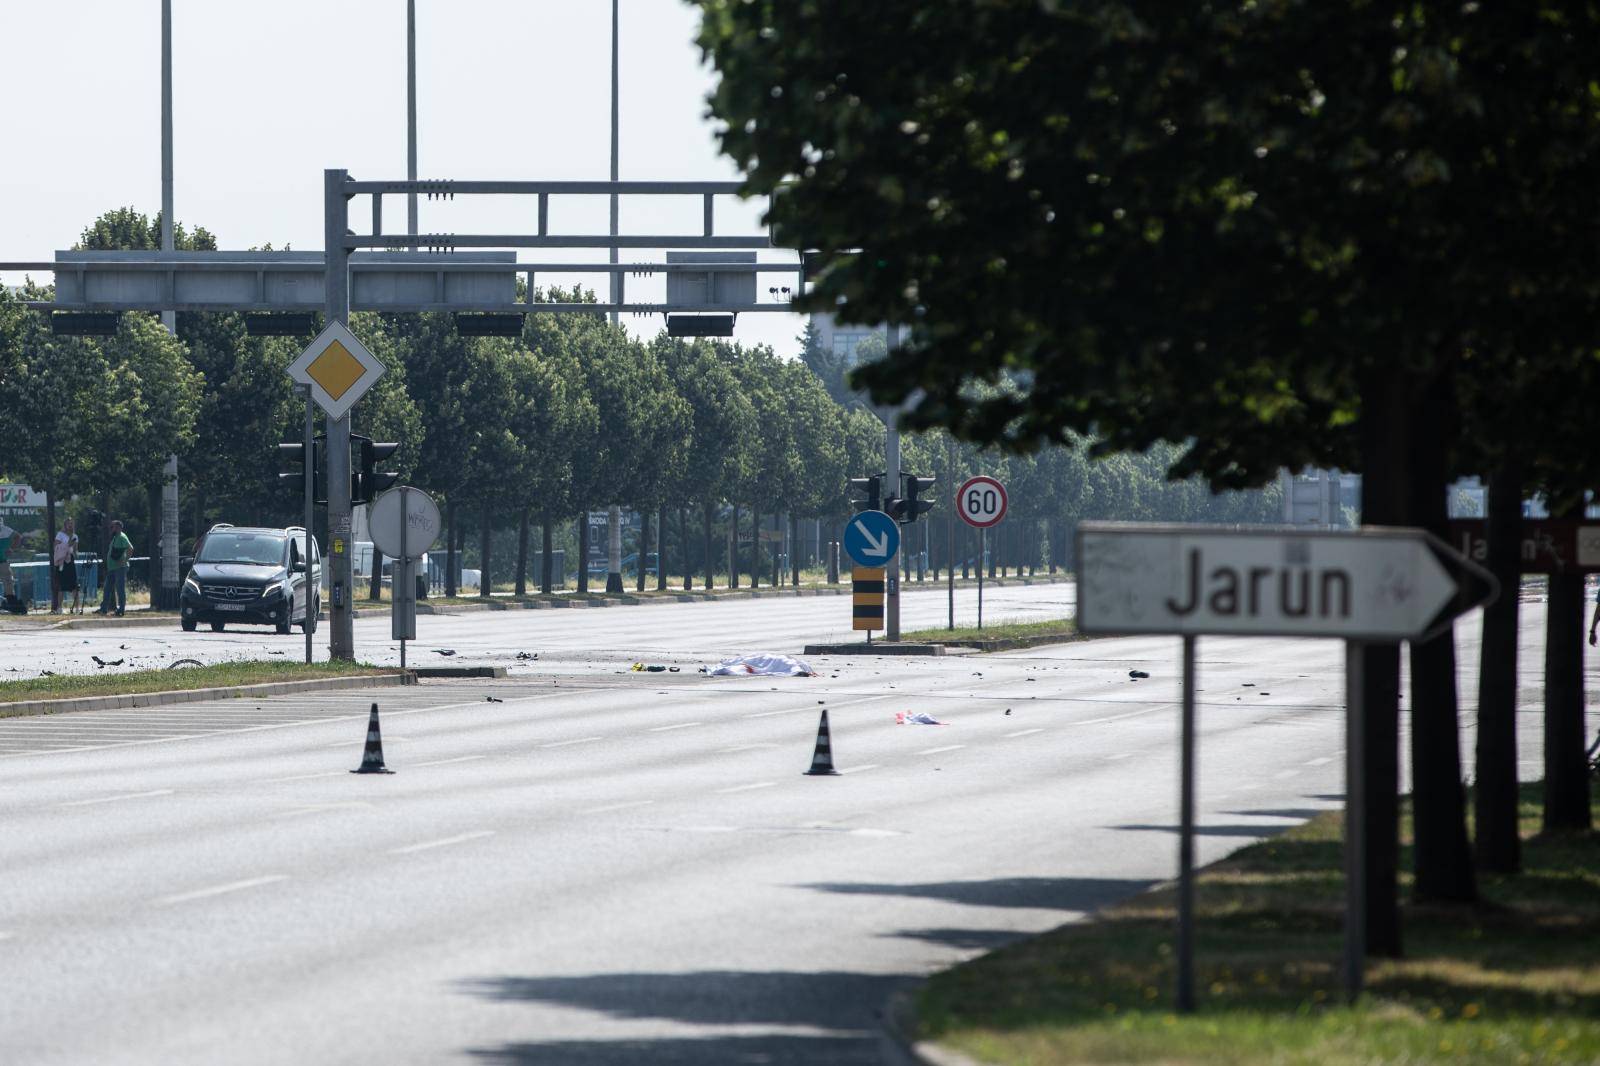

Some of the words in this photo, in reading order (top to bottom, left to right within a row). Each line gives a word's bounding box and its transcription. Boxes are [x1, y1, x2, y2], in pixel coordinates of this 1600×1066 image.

[968, 490, 996, 514] 60
[1461, 531, 1537, 560] Jan
[1165, 547, 1352, 617] Jarun
